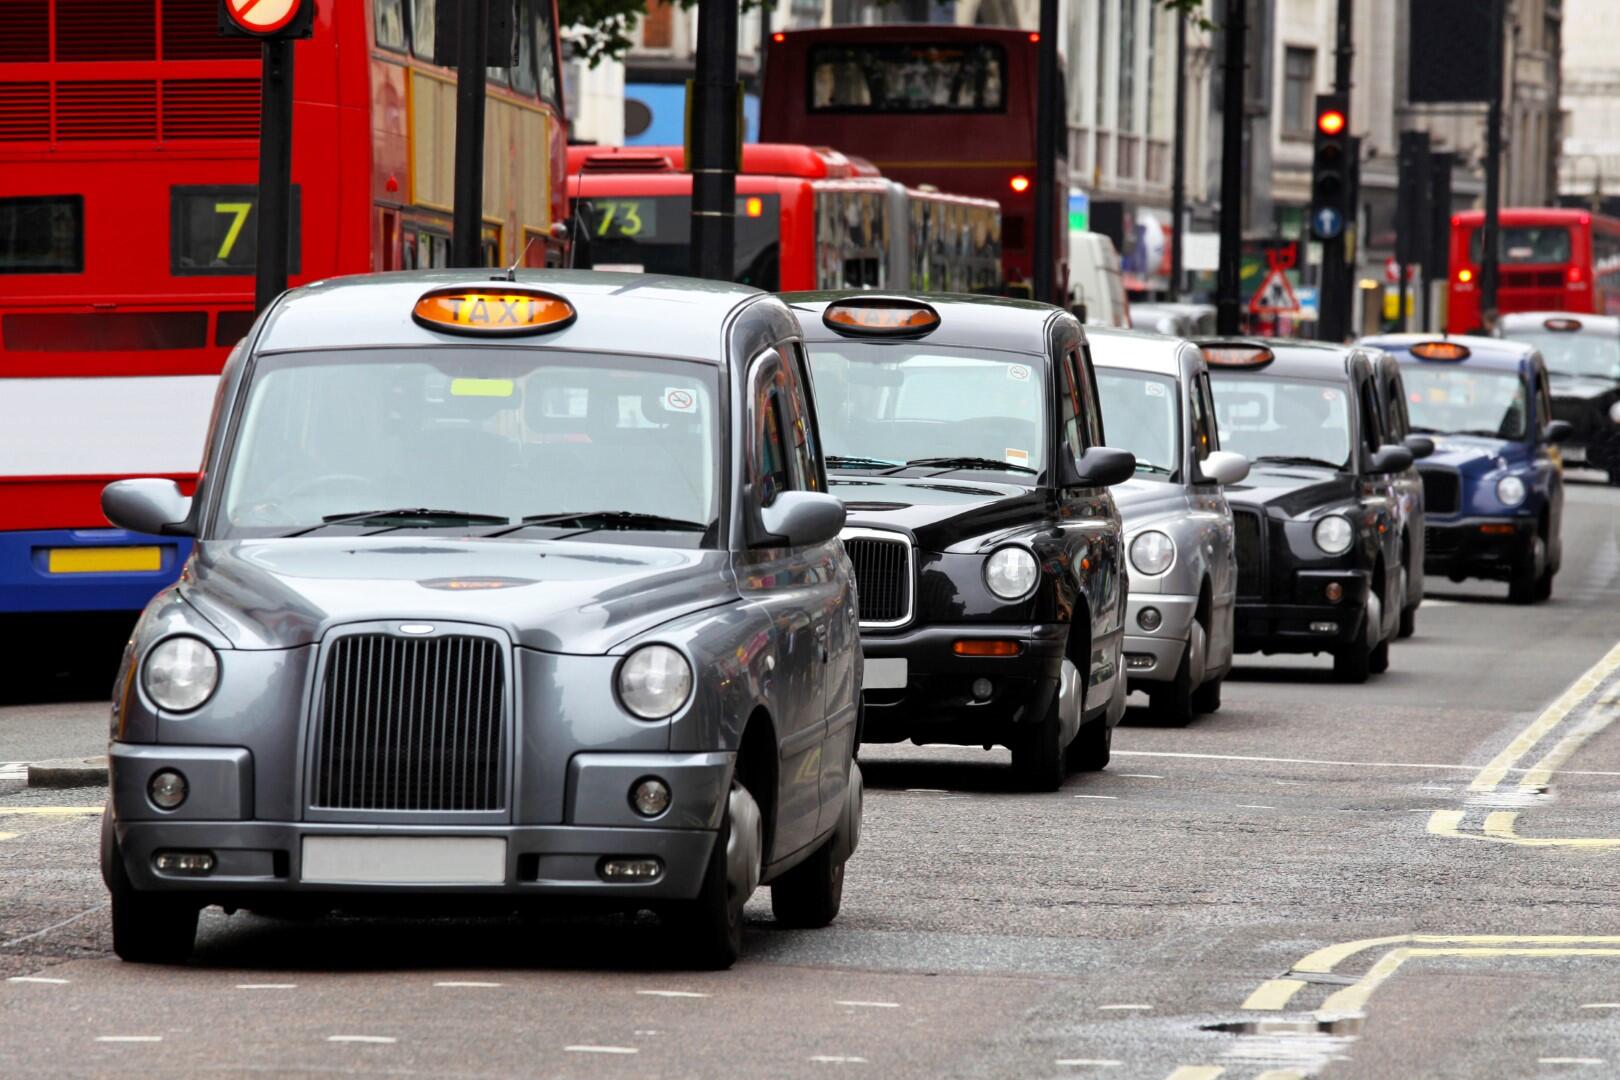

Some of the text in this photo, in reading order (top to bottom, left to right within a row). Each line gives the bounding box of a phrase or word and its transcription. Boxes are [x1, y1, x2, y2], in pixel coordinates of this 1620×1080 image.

[215, 203, 252, 259] 7
[595, 202, 642, 236] 73
[448, 297, 536, 324] TAXI
